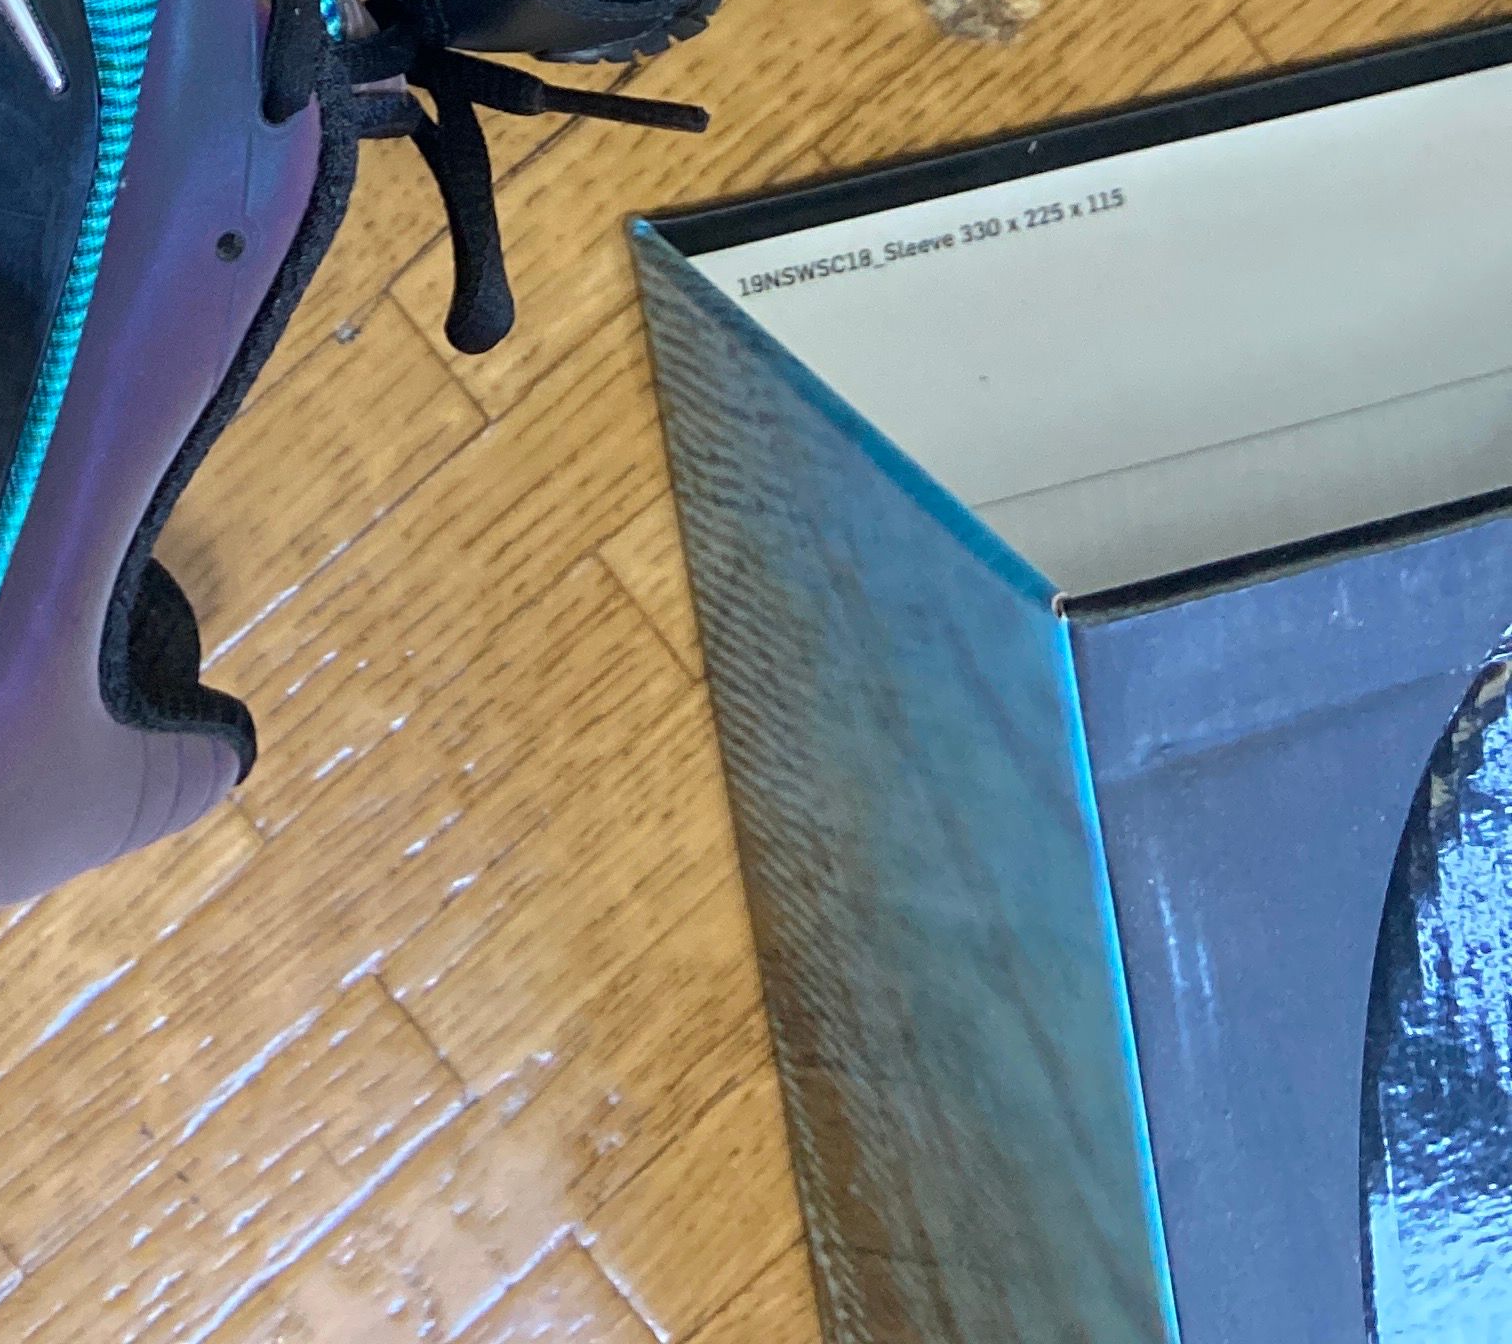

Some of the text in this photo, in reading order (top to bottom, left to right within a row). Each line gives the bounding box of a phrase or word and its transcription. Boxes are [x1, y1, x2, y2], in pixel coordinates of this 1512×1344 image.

[959, 217, 1002, 243] 330
[1007, 219, 1020, 233] x
[1024, 203, 1064, 229] 225
[1069, 203, 1083, 217] x
[1088, 188, 1125, 213] 115
